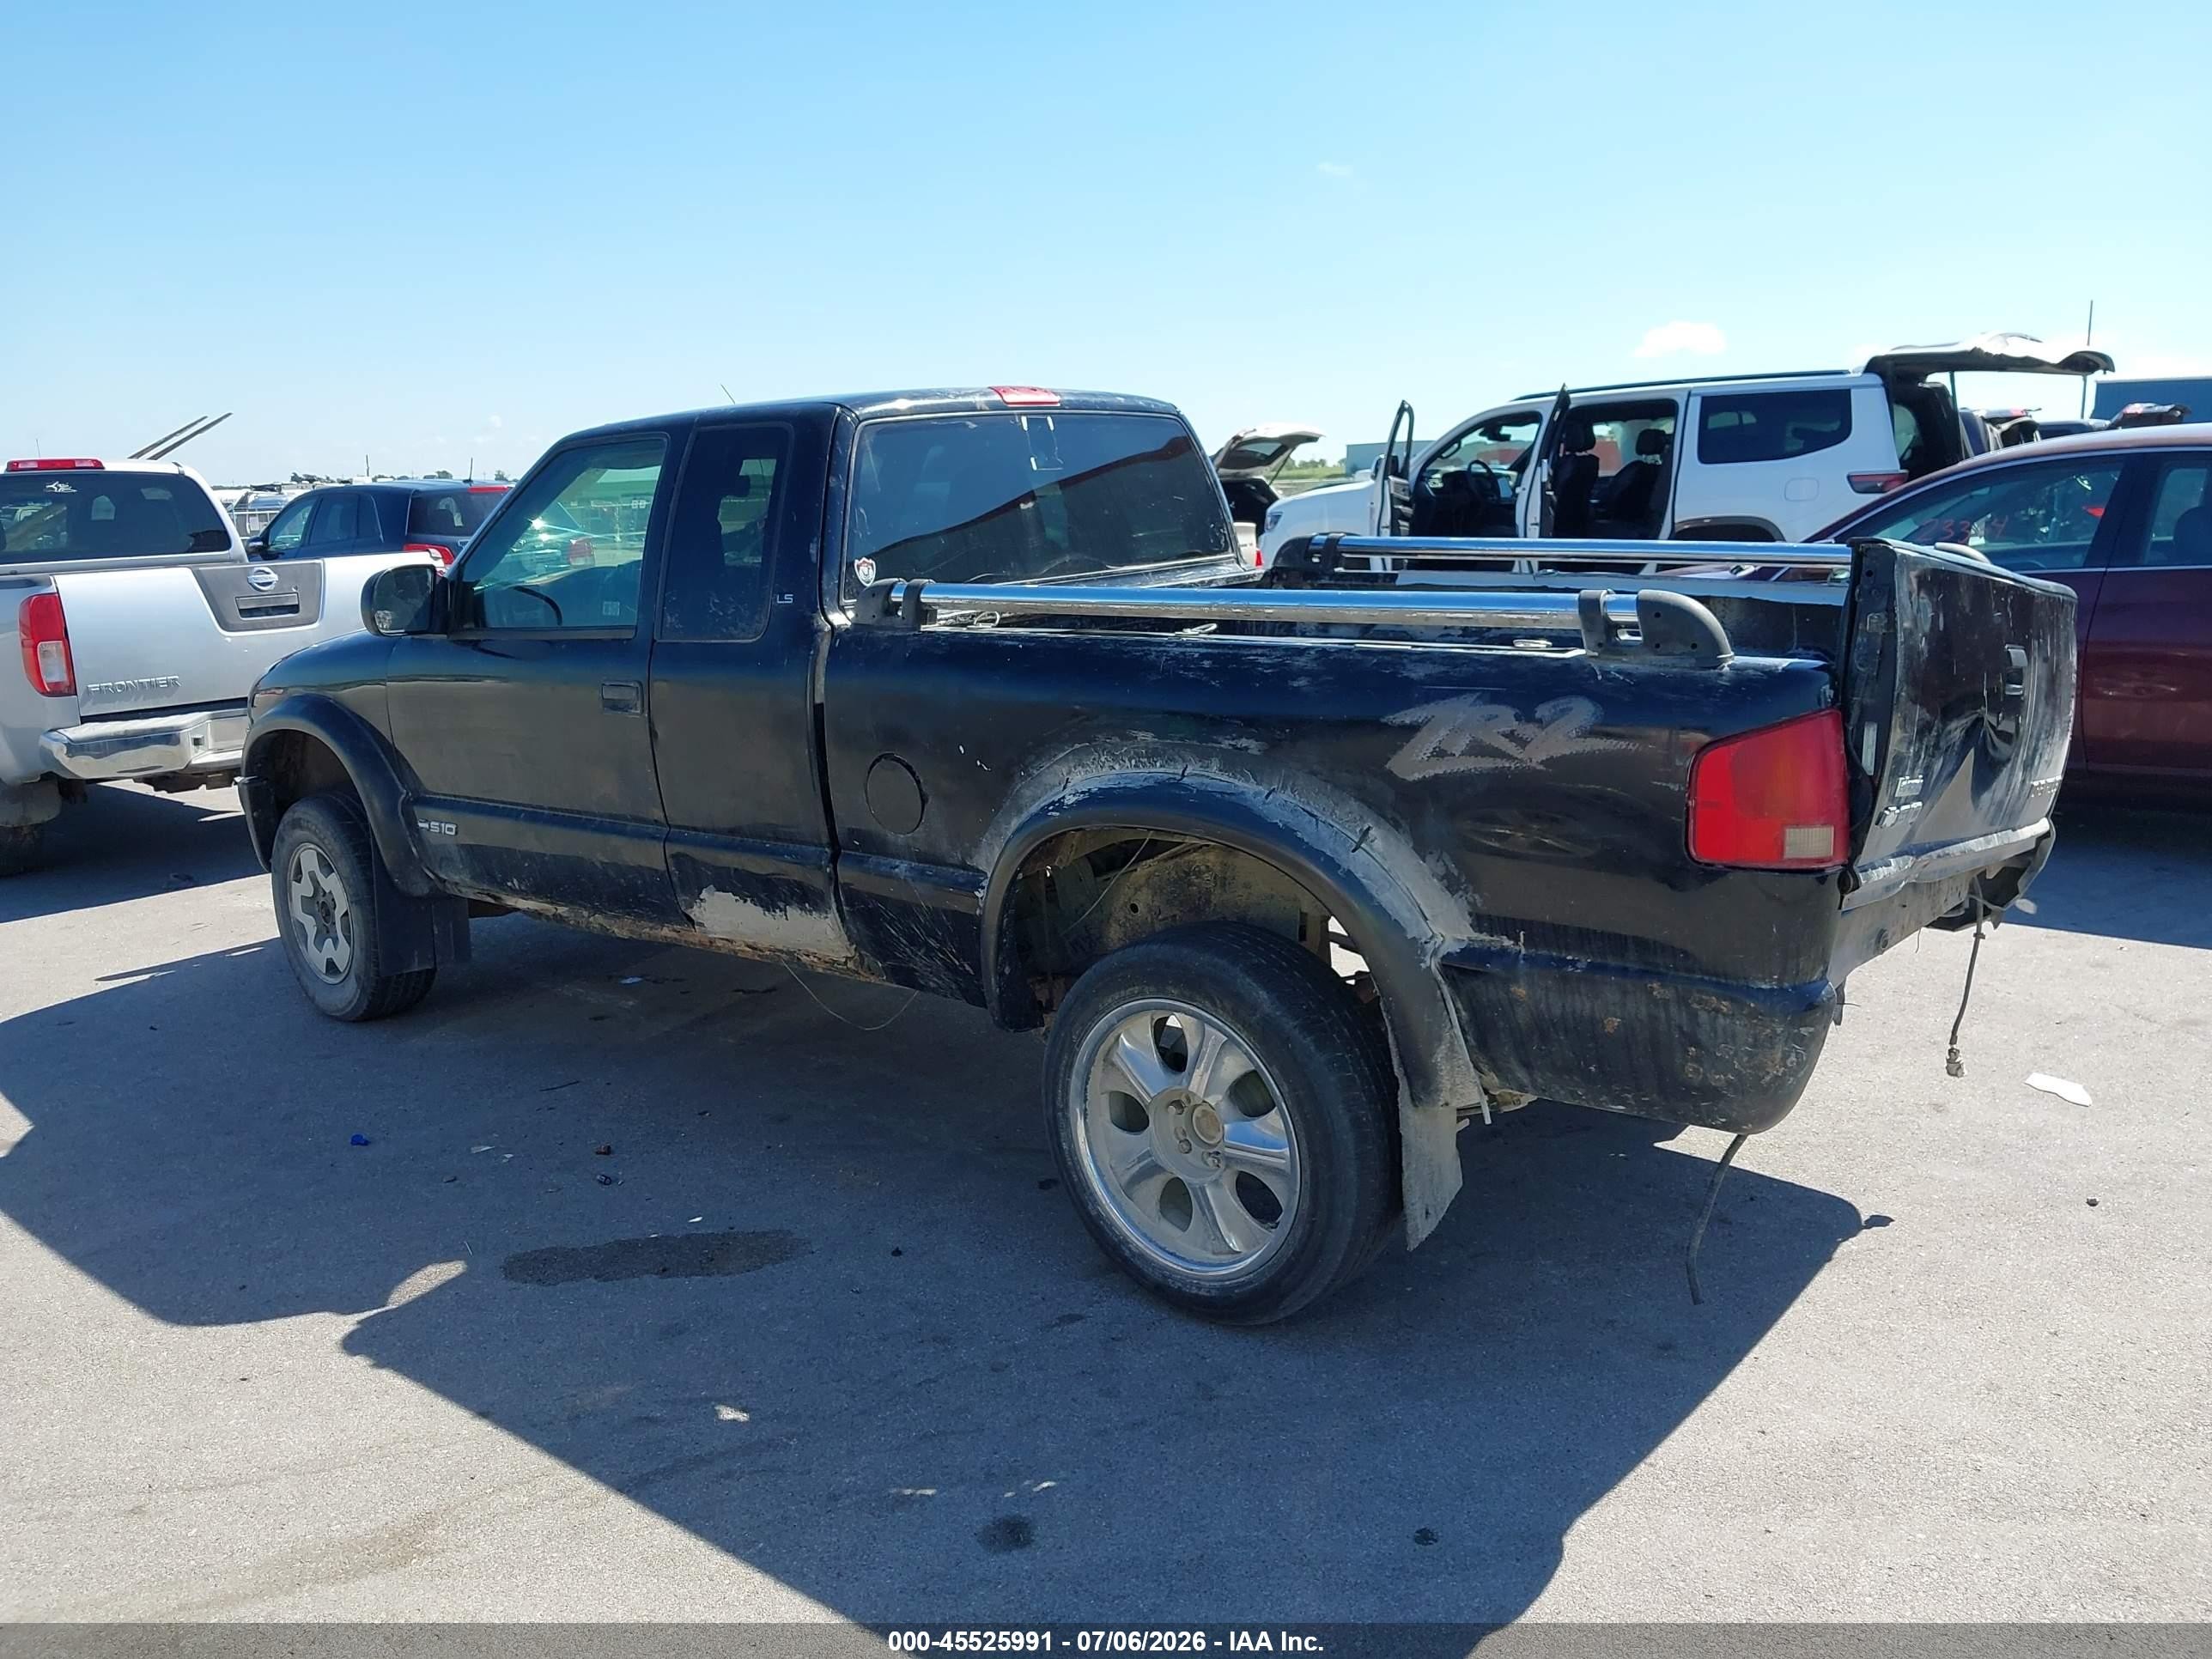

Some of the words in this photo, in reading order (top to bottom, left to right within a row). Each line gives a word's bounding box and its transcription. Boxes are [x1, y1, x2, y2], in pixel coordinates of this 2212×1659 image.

[1917, 515, 2008, 544] 2334
[776, 593, 793, 604] LS
[87, 675, 182, 695] FRONTIER
[429, 820, 457, 836] S10
